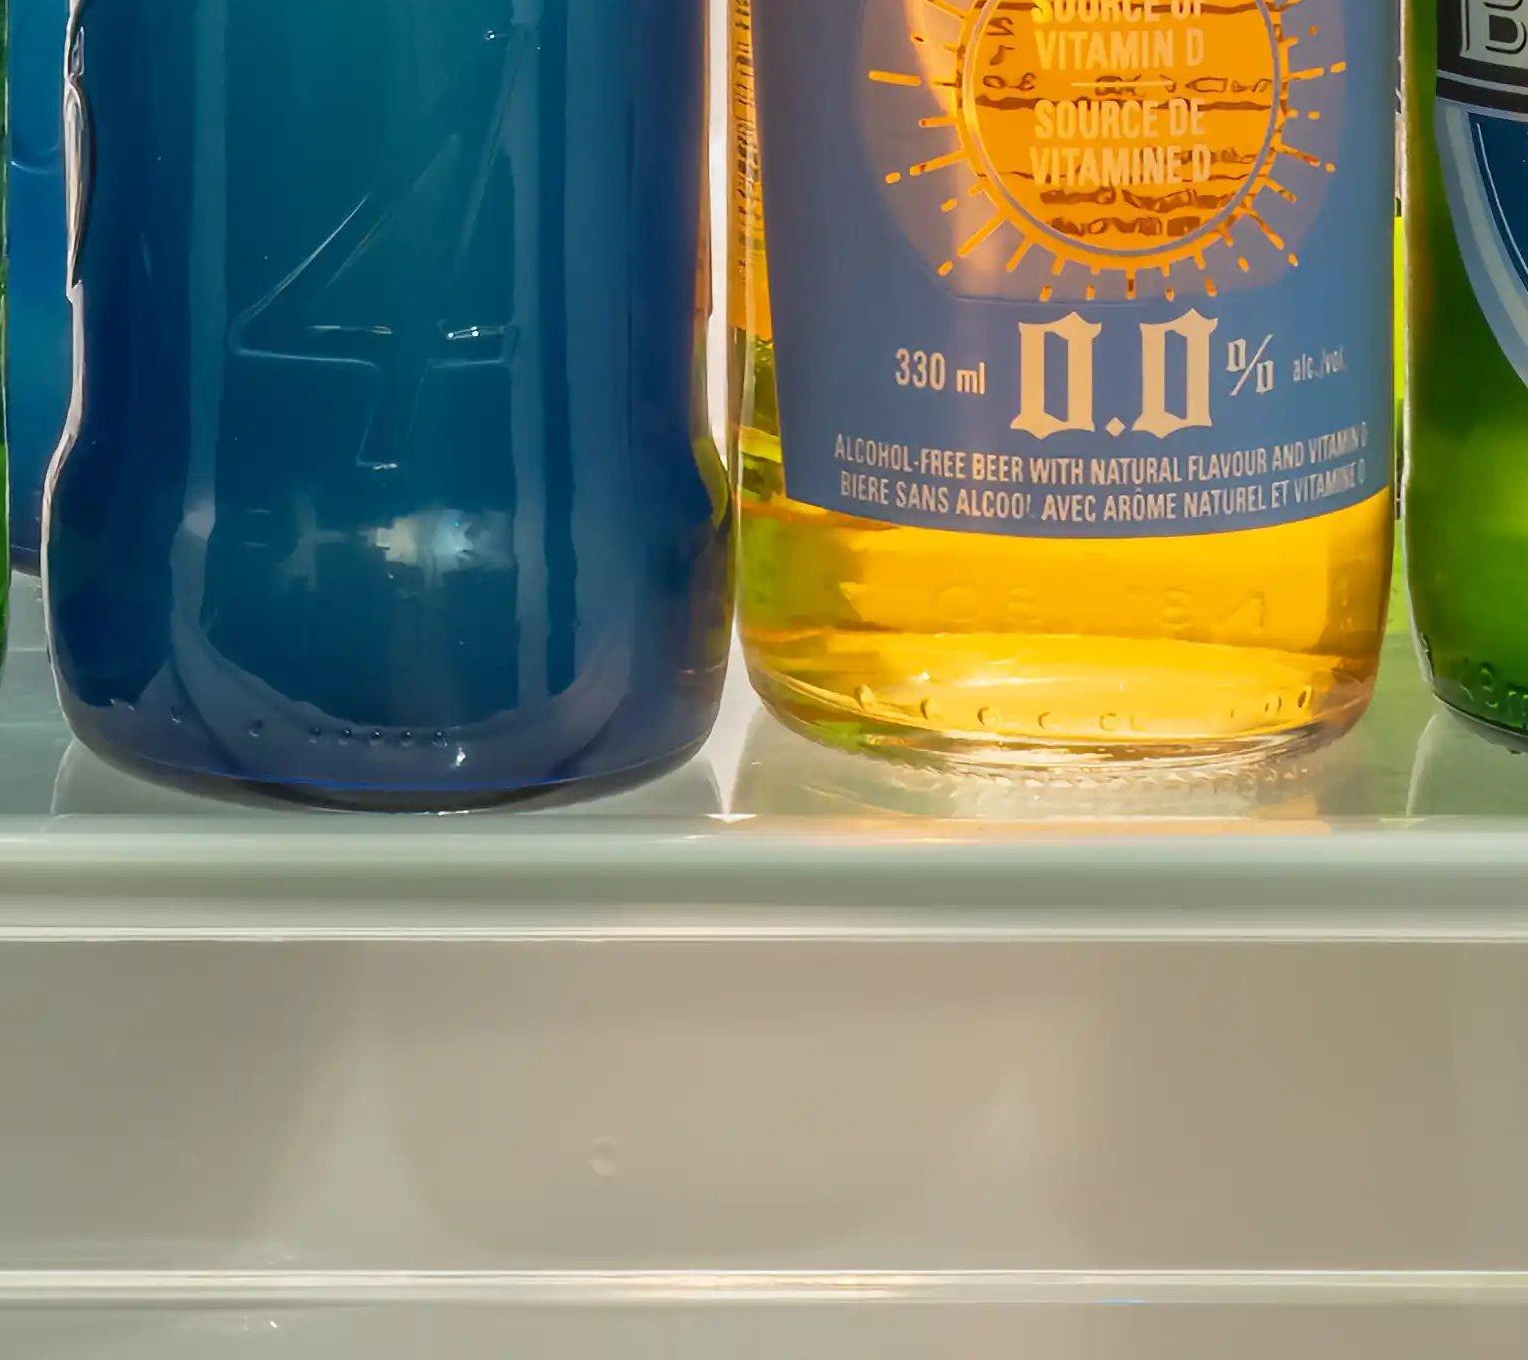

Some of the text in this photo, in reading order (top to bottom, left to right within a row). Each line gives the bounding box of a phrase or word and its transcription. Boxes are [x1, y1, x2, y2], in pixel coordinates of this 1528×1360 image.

[1034, 27, 1205, 71] VITAMIN D
[1033, 96, 1207, 141] SOURCE DE
[1029, 142, 1212, 188] VITAMINE D
[894, 347, 947, 392] 330
[955, 361, 986, 396] ml
[833, 433, 967, 480] ALCOHOL-FREE
[971, 452, 1023, 483] BEER
[1029, 457, 1085, 486] WITH
[1090, 454, 1183, 487] NATURAL
[1188, 444, 1268, 482] FLAVOUR
[1272, 441, 1305, 472] AND
[895, 480, 950, 514] SANS
[1041, 493, 1097, 524] AVEC
[1102, 487, 1178, 523] ARÔME
[1183, 484, 1267, 519] NATUREL
[1271, 476, 1291, 507] ET
